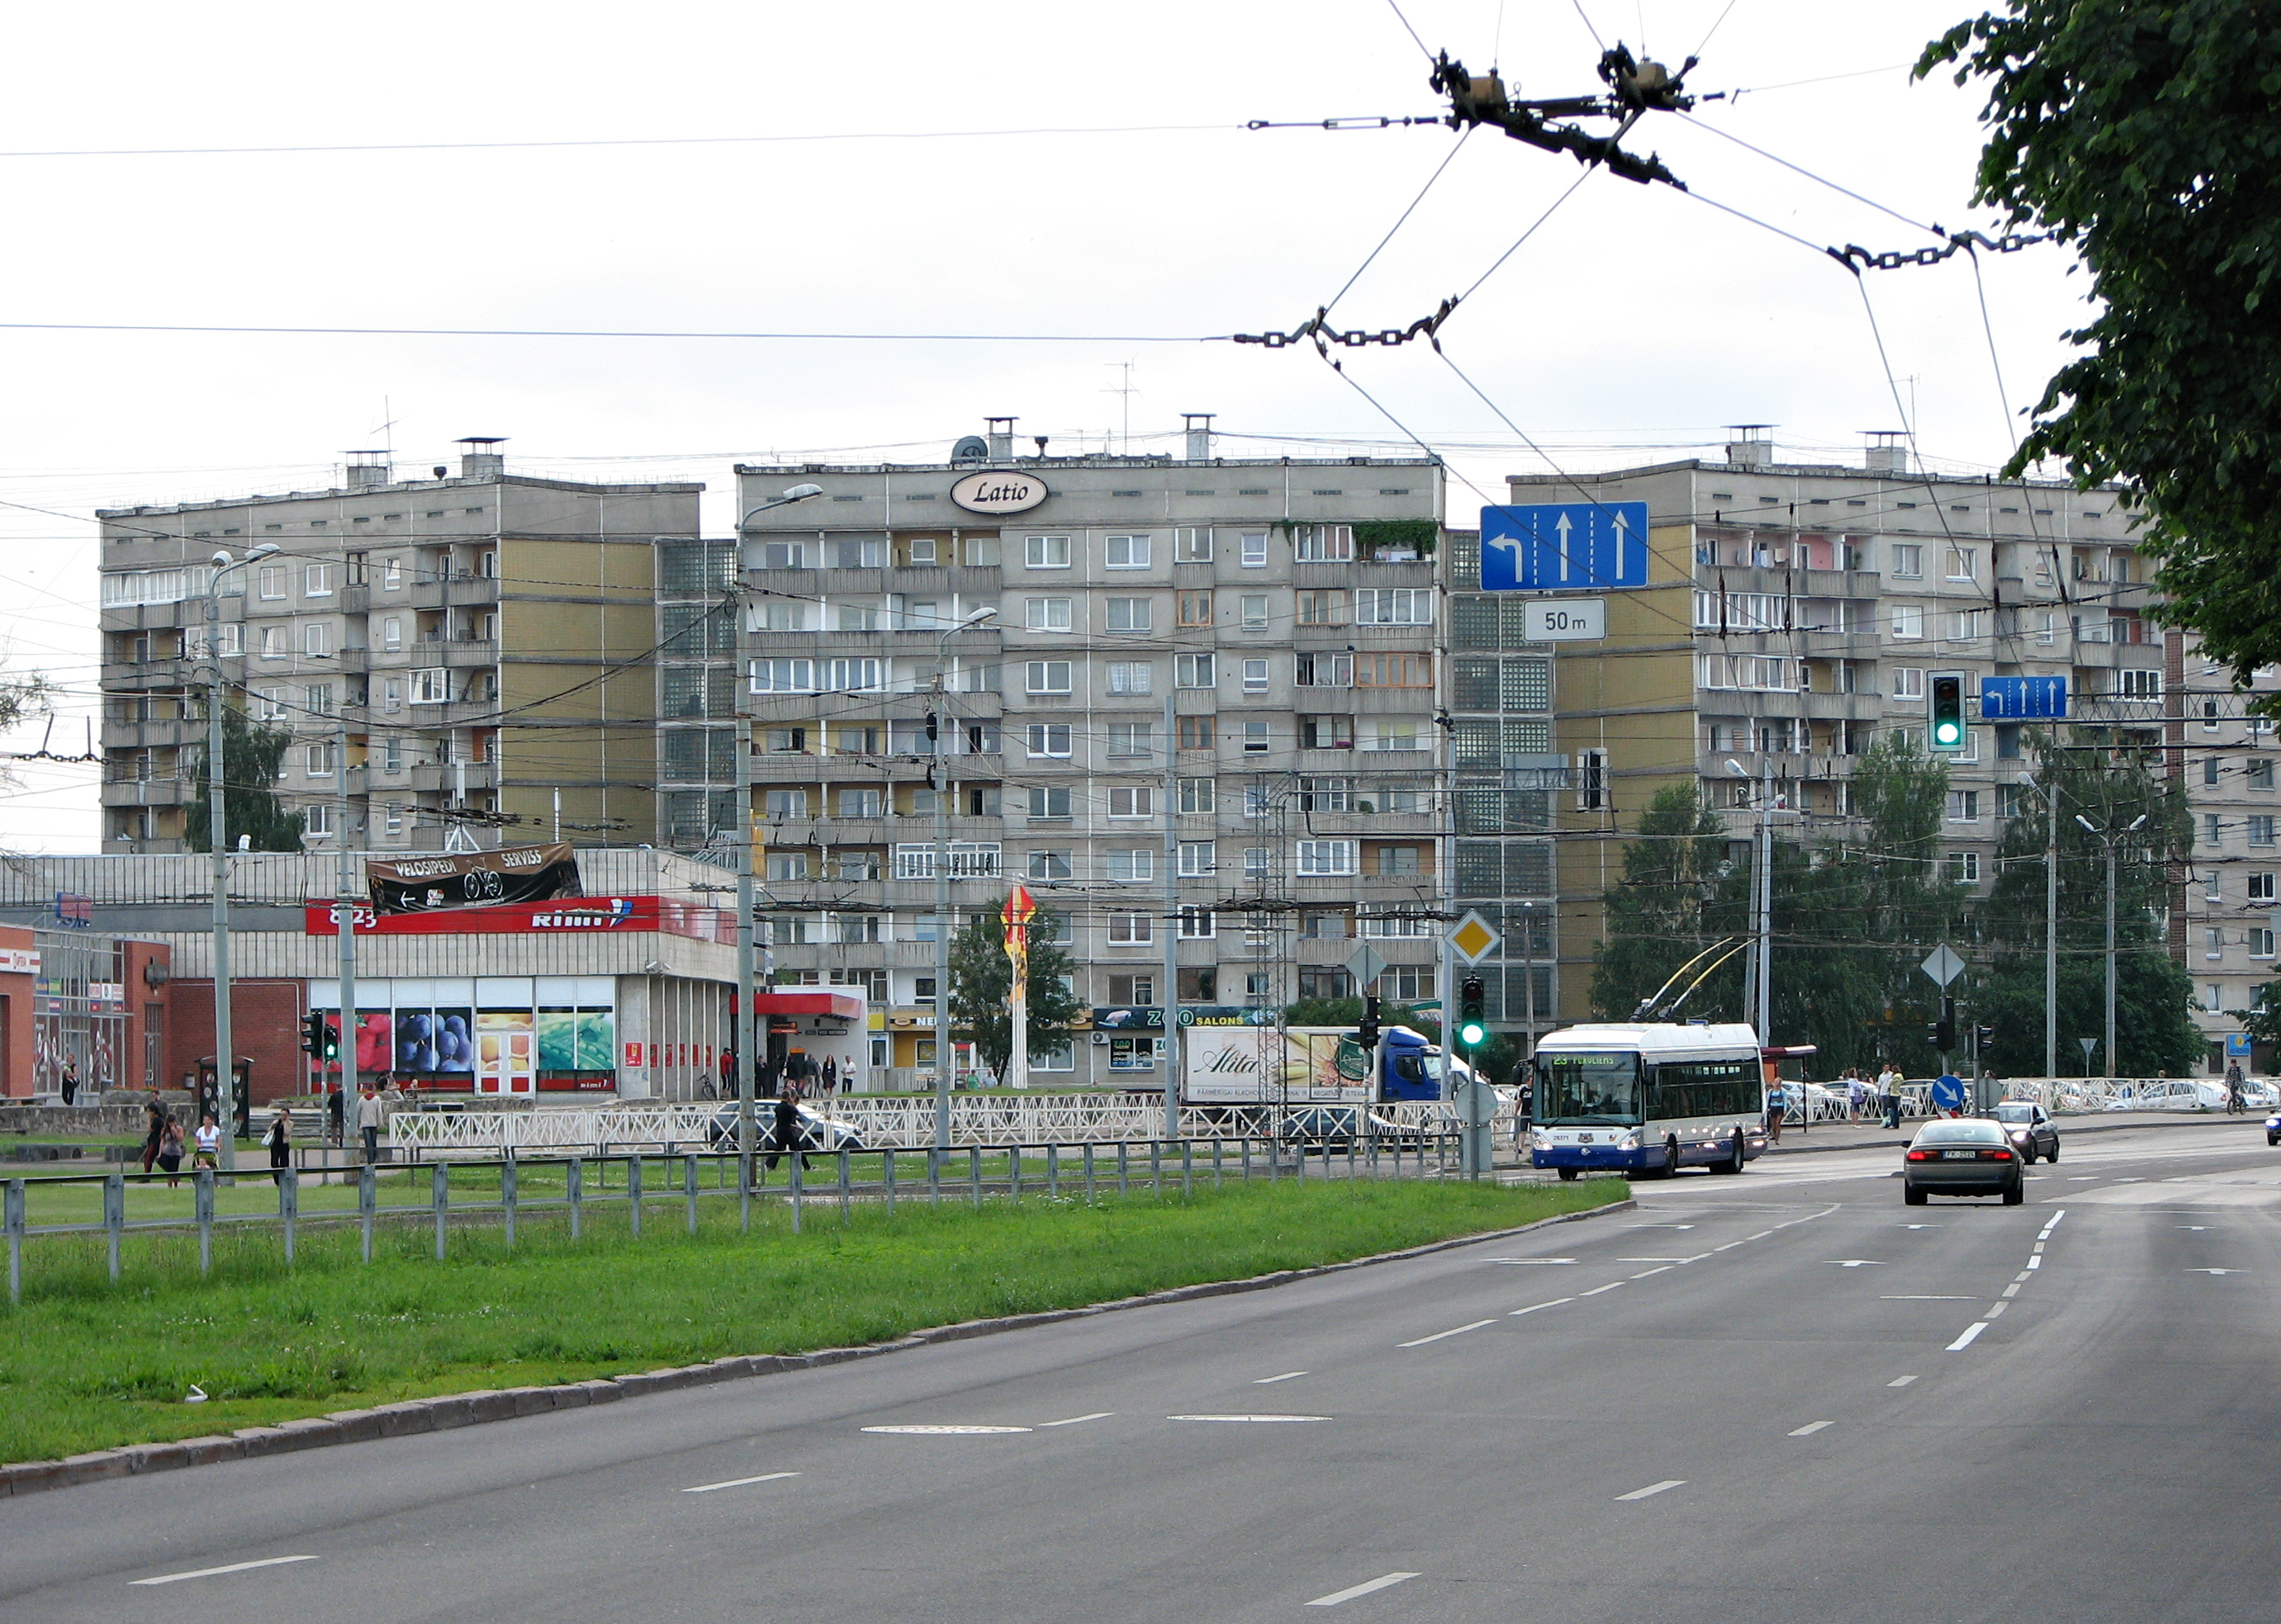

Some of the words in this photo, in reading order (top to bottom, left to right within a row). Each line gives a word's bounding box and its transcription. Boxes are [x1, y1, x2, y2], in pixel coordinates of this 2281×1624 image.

[973, 481, 1028, 502] Latio
[1545, 612, 1567, 630] 50
[1572, 618, 1586, 629] m
[395, 859, 458, 877] VELOSIPEDI
[500, 849, 543, 868] SERVISS
[1196, 1016, 1244, 1025] SALONS
[1193, 1044, 1259, 1073] Alita
[1553, 1054, 1567, 1065] 23
